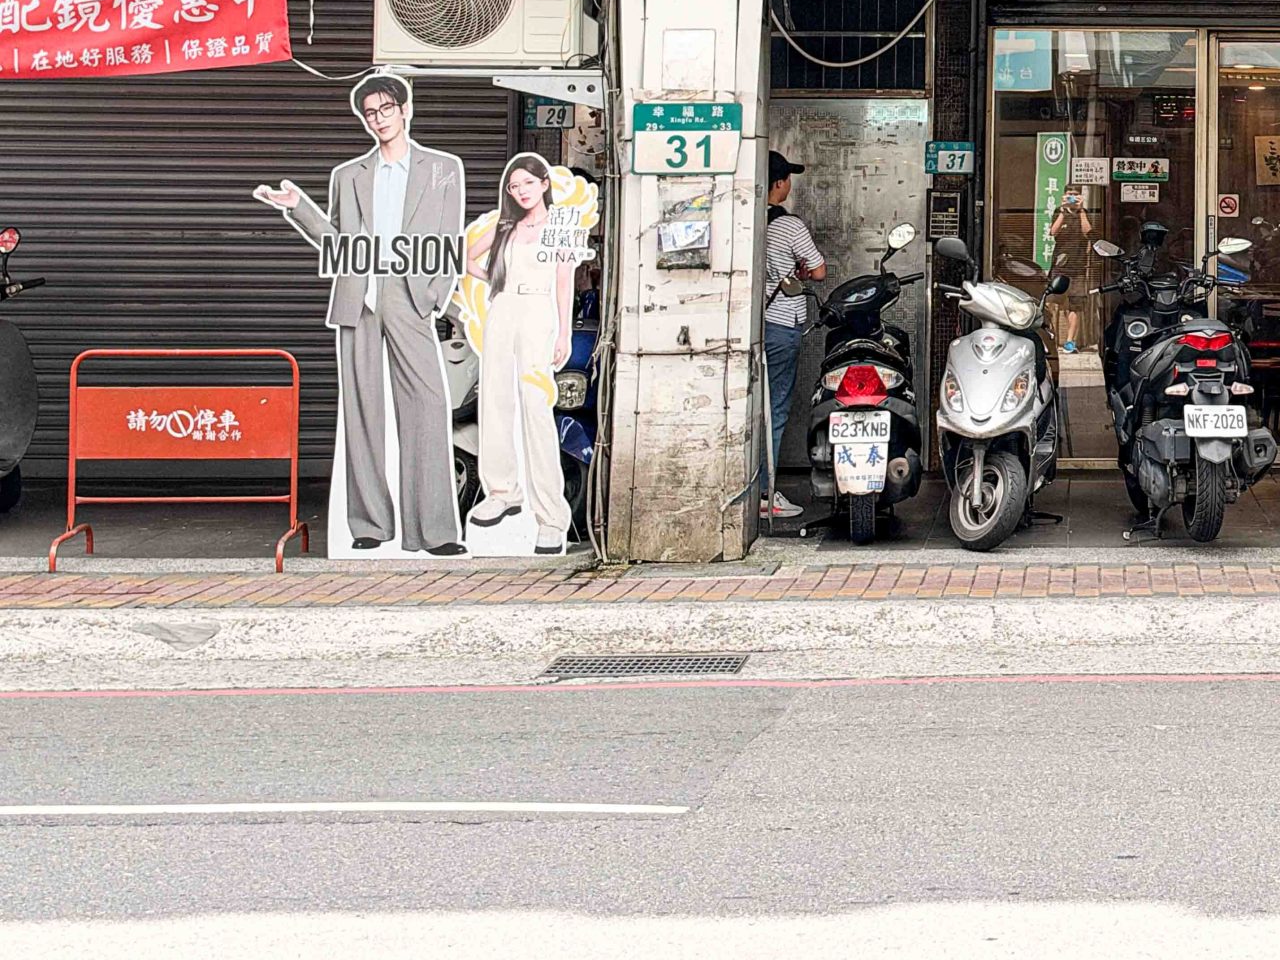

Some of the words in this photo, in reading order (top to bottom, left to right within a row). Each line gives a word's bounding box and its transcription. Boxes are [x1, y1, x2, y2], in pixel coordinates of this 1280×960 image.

[30, 43, 154, 72] 在地好服務
[181, 30, 274, 57] 保證品質
[546, 108, 566, 125] 29
[652, 105, 724, 118] 幸福路
[645, 123, 658, 131] 29
[720, 123, 732, 131] 33
[670, 117, 693, 125] Xingfu
[665, 134, 712, 169] 31
[946, 153, 966, 170] 31
[1116, 160, 1146, 172] 營業中
[550, 206, 580, 226] 活力
[541, 228, 587, 248] 超氣質
[321, 235, 464, 276] MOLSION
[537, 250, 577, 263] QINA
[126, 408, 168, 432] 請勿
[194, 408, 240, 432] 停車
[1187, 413, 1244, 429] NKF-2028
[192, 429, 242, 441] 謝謝合作
[831, 422, 888, 438] 623-KNB
